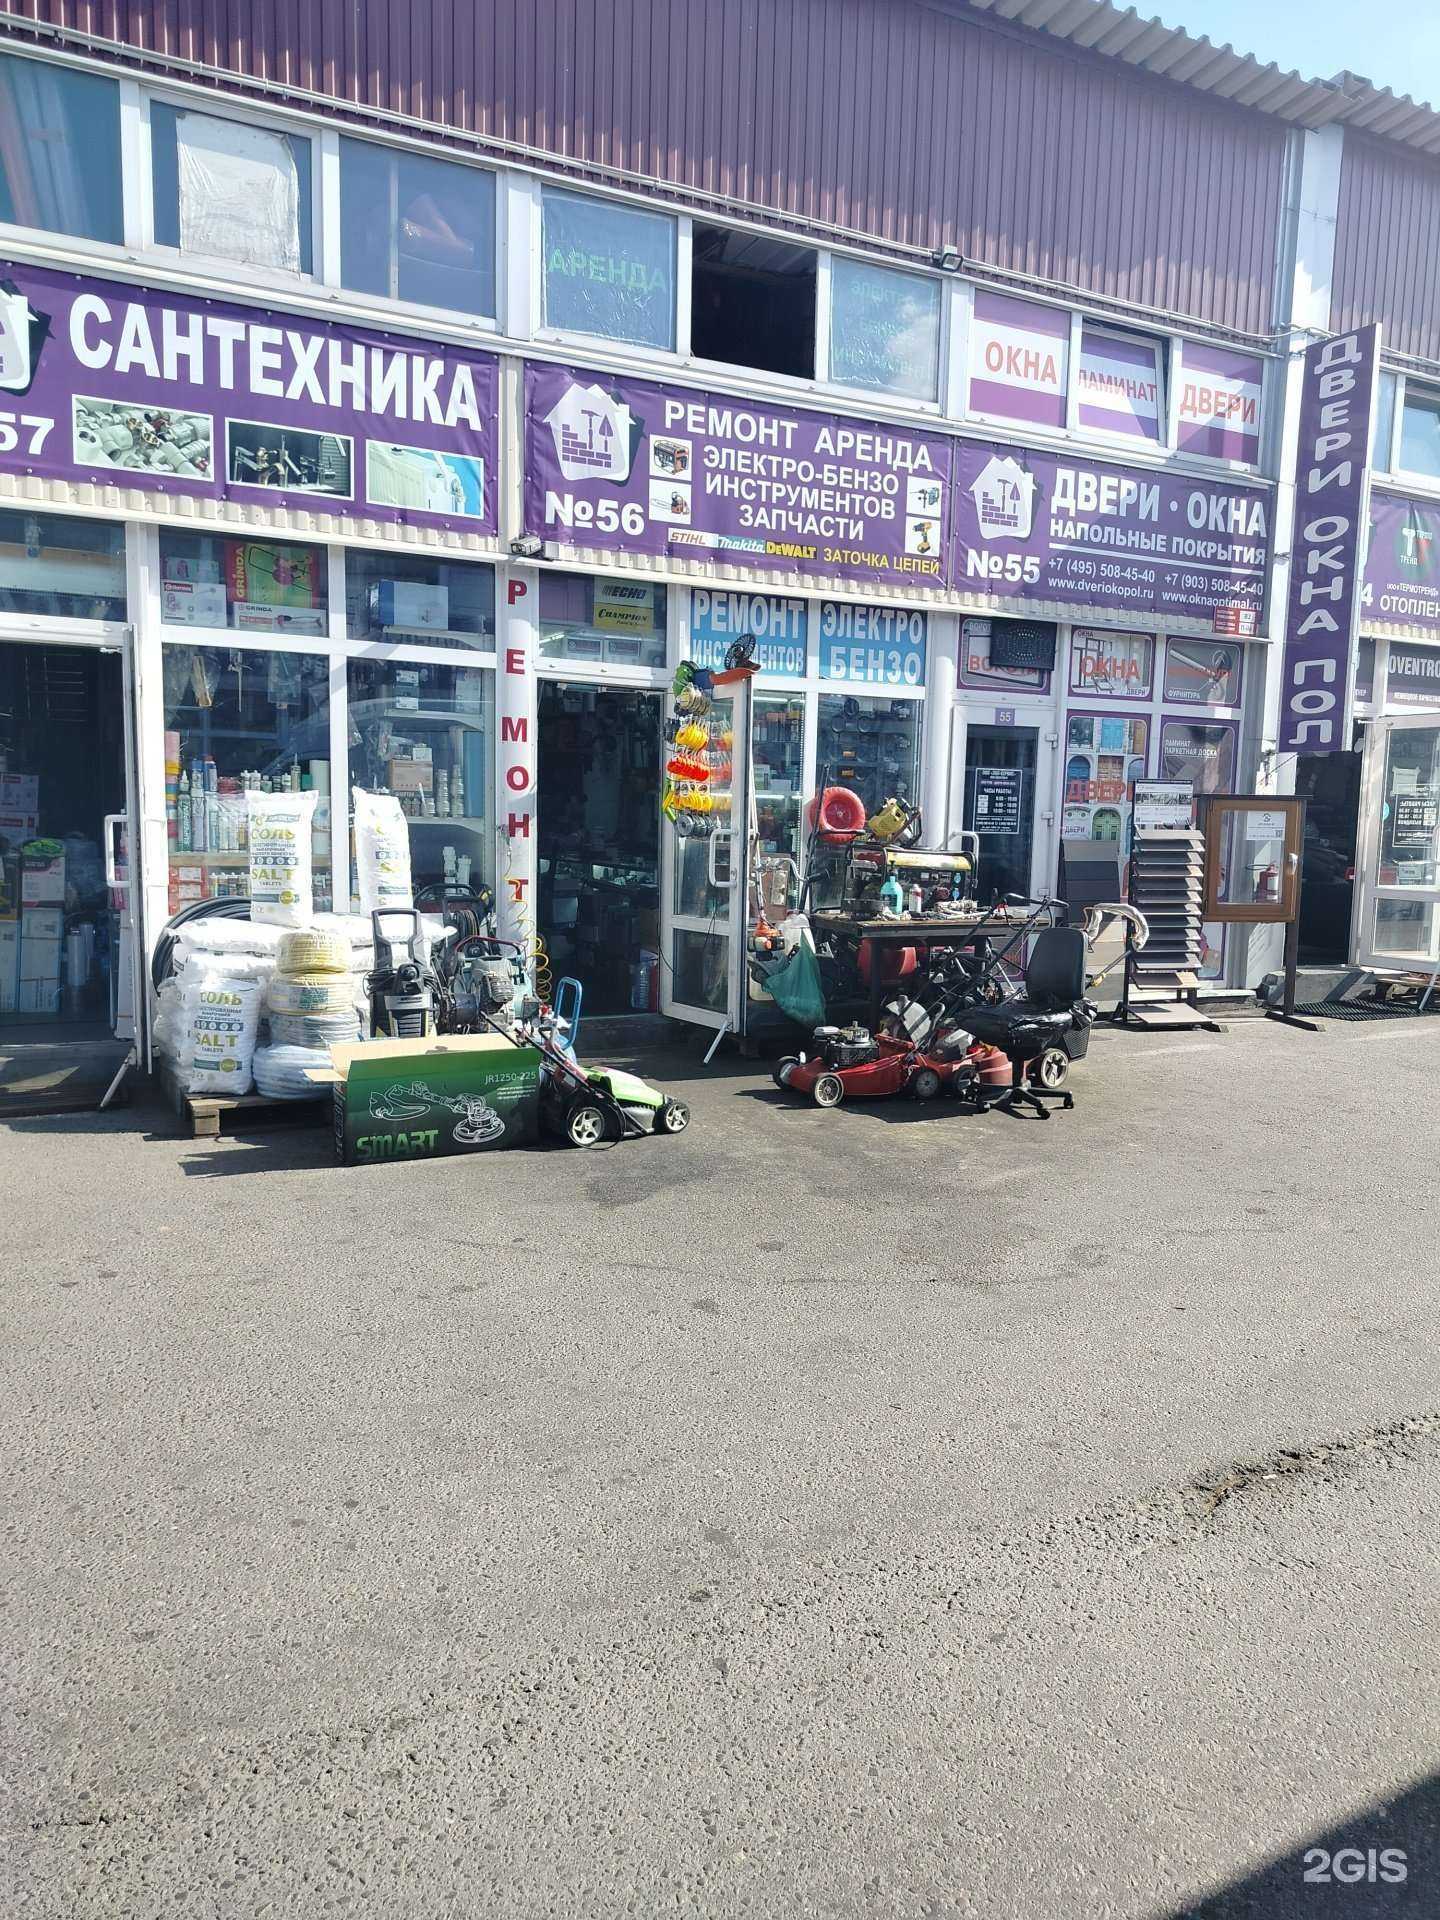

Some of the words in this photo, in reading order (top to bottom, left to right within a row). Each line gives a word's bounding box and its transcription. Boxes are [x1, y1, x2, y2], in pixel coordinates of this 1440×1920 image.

[547, 247, 666, 293] АРЕНДА
[69, 294, 483, 432] САНТЕХНИКА
[985, 340, 1058, 385] ОКНА
[1179, 383, 1256, 425] ДВЕРИ
[1307, 334, 1362, 494] ДВЕРИ
[665, 400, 798, 449] РЕМОНТ
[814, 428, 933, 472] АРЕНДА
[703, 445, 899, 495] ЭЛЕКТРО-БЕНЗО
[545, 490, 645, 536] №56
[705, 475, 896, 520] ИНСТРУМЕНТОВ
[1050, 467, 1159, 523] ДВЕРИ
[1187, 491, 1268, 538] ОКНА
[671, 532, 706, 546] STIHL
[738, 504, 864, 541] ЗАПЧАСТИ
[1050, 518, 1167, 553] НАПОЛЬНЫЕ
[1172, 536, 1267, 566] ПОКРЫТИЯ
[1400, 554, 1418, 566] ТРЕНД
[823, 547, 889, 569] ЗАТОЧКА
[893, 555, 941, 575] ЦЕПЕЙ
[966, 549, 1042, 585] №55
[1049, 558, 1063, 571] +7
[1067, 558, 1097, 578] (495)
[1100, 563, 1155, 583] 508-45-40
[1164, 573, 1179, 586] +7
[1181, 574, 1208, 593] (903)
[1211, 579, 1264, 596] 508-45-40
[1297, 515, 1350, 636] ОКНА
[611, 585, 647, 600] ECHO
[1048, 576, 1154, 599] www.dveriokopol.ru
[693, 589, 805, 639] РЕМОНТ
[822, 602, 924, 644] ЭЛЕКТРО
[829, 646, 922, 686] БЕНЗО
[1081, 655, 1140, 681] ОКНА
[999, 711, 1011, 723] 55
[1287, 657, 1337, 745] ПОЛ
[1165, 739, 1191, 747] ЛАМИНАТ
[251, 828, 296, 840] СОЛЬ
[1064, 825, 1085, 834] ДВЕРИ
[251, 868, 295, 880] SALT
[199, 991, 242, 1006] СОЛЬ
[194, 1033, 239, 1047] SALT
[484, 1070, 537, 1085] JR1250-225
[356, 1129, 440, 1158] SMART
